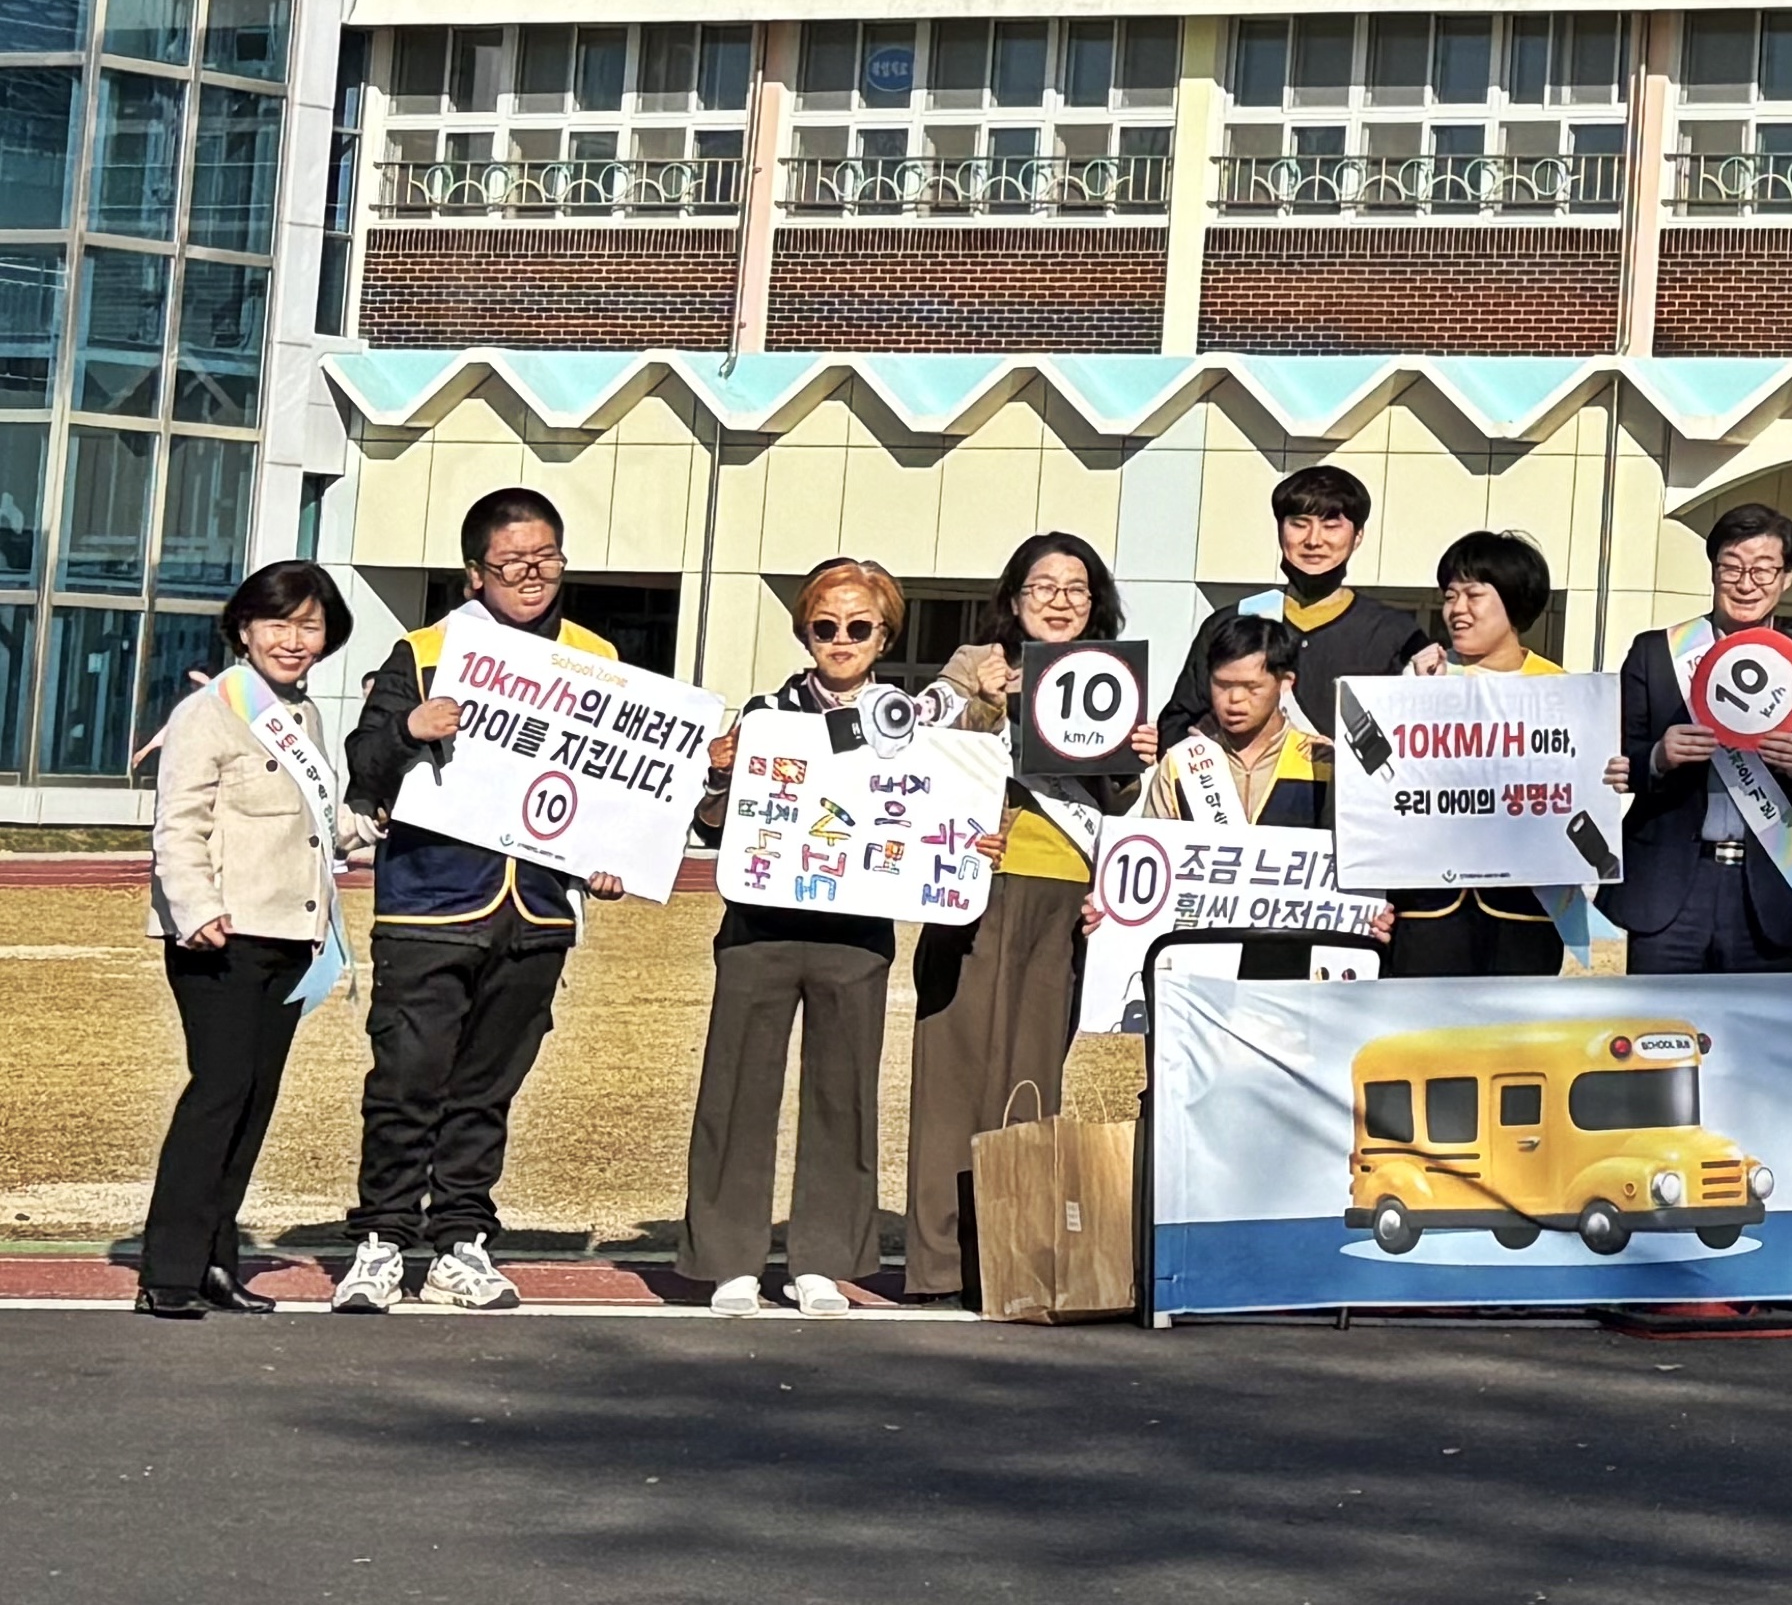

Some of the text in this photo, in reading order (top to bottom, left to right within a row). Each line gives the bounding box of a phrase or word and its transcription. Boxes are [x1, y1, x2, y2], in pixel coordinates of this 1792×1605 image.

[458, 650, 705, 760] 10km/h의 배려가
[1056, 670, 1122, 722] 10
[1715, 658, 1769, 713] 10
[456, 698, 676, 803] 아이를 지킵니다.
[1063, 729, 1105, 746] km/h
[1392, 721, 1577, 759] 10KM/H 이하,
[534, 789, 568, 824] 10
[1394, 782, 1573, 817] 우리 아이의 생명선
[794, 796, 857, 903] 사고도
[1174, 844, 1244, 885] 조금
[1116, 853, 1158, 905] 10
